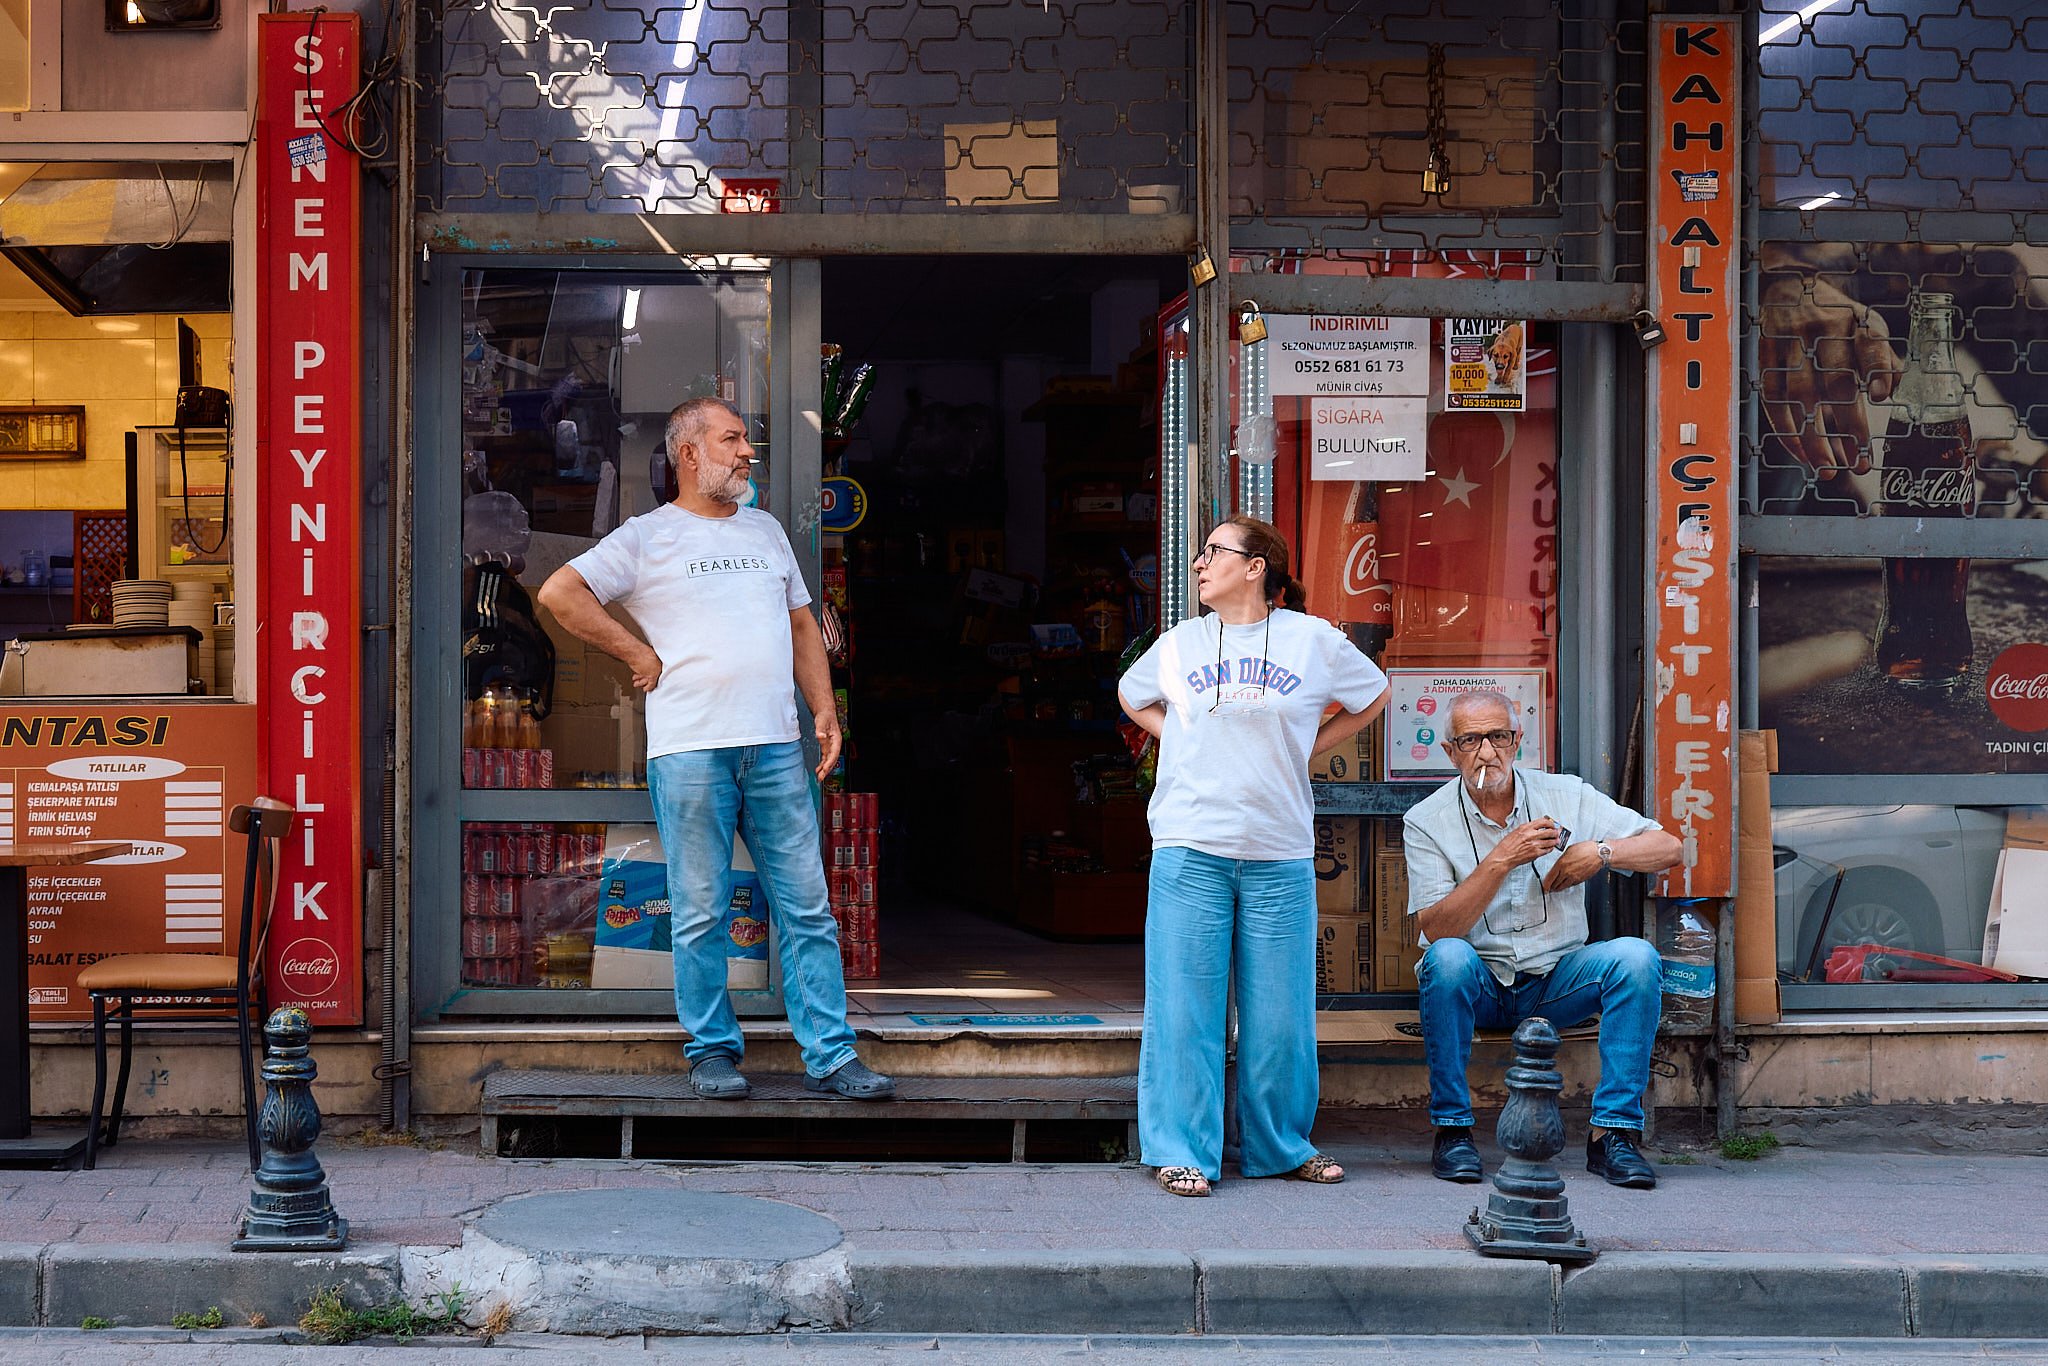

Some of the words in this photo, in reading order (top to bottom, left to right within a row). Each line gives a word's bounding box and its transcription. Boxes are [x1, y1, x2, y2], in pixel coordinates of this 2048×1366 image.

[1671, 26, 1724, 389] KAHALTI
[1452, 318, 1503, 335] KAYIP!
[1281, 341, 1346, 351] SEZONUMUZ
[1348, 341, 1417, 352] BAŞLAMIŞTIR.
[1295, 360, 1330, 373] 0552
[1334, 360, 1361, 373] 681
[1365, 360, 1382, 373] 61
[1387, 360, 1404, 373] 73
[1316, 380, 1351, 392] MÜNİR
[1354, 380, 1383, 393] CİVAŞ
[1317, 407, 1384, 424] SİGARA
[1318, 438, 1411, 453] BULUNUR.
[689, 558, 769, 574] FEARLESS
[1187, 659, 1232, 694] SAN
[1238, 657, 1302, 696] DIEGO
[1985, 742, 2030, 753] TADINI
[89, 763, 147, 773] TATLILAR
[28, 782, 84, 795] KEMALPAŞA
[86, 781, 119, 792] TATLISI
[27, 797, 82, 809] ŞEKERPARE
[84, 796, 117, 807] TATLISI
[28, 809, 56, 822] İRMİK
[58, 811, 97, 821] HELVASI
[28, 826, 54, 836] FIRIN
[55, 824, 91, 838] SÜTLAÇ
[28, 875, 49, 888] ŞİŞE
[28, 892, 54, 901] KUTU
[28, 906, 63, 916] AYRAN
[28, 920, 56, 930] SODA
[28, 935, 42, 944] SU
[283, 958, 335, 975] Coca-Cola
[281, 1001, 310, 1009] TADINI
[311, 1001, 338, 1010] ÇIKAR
